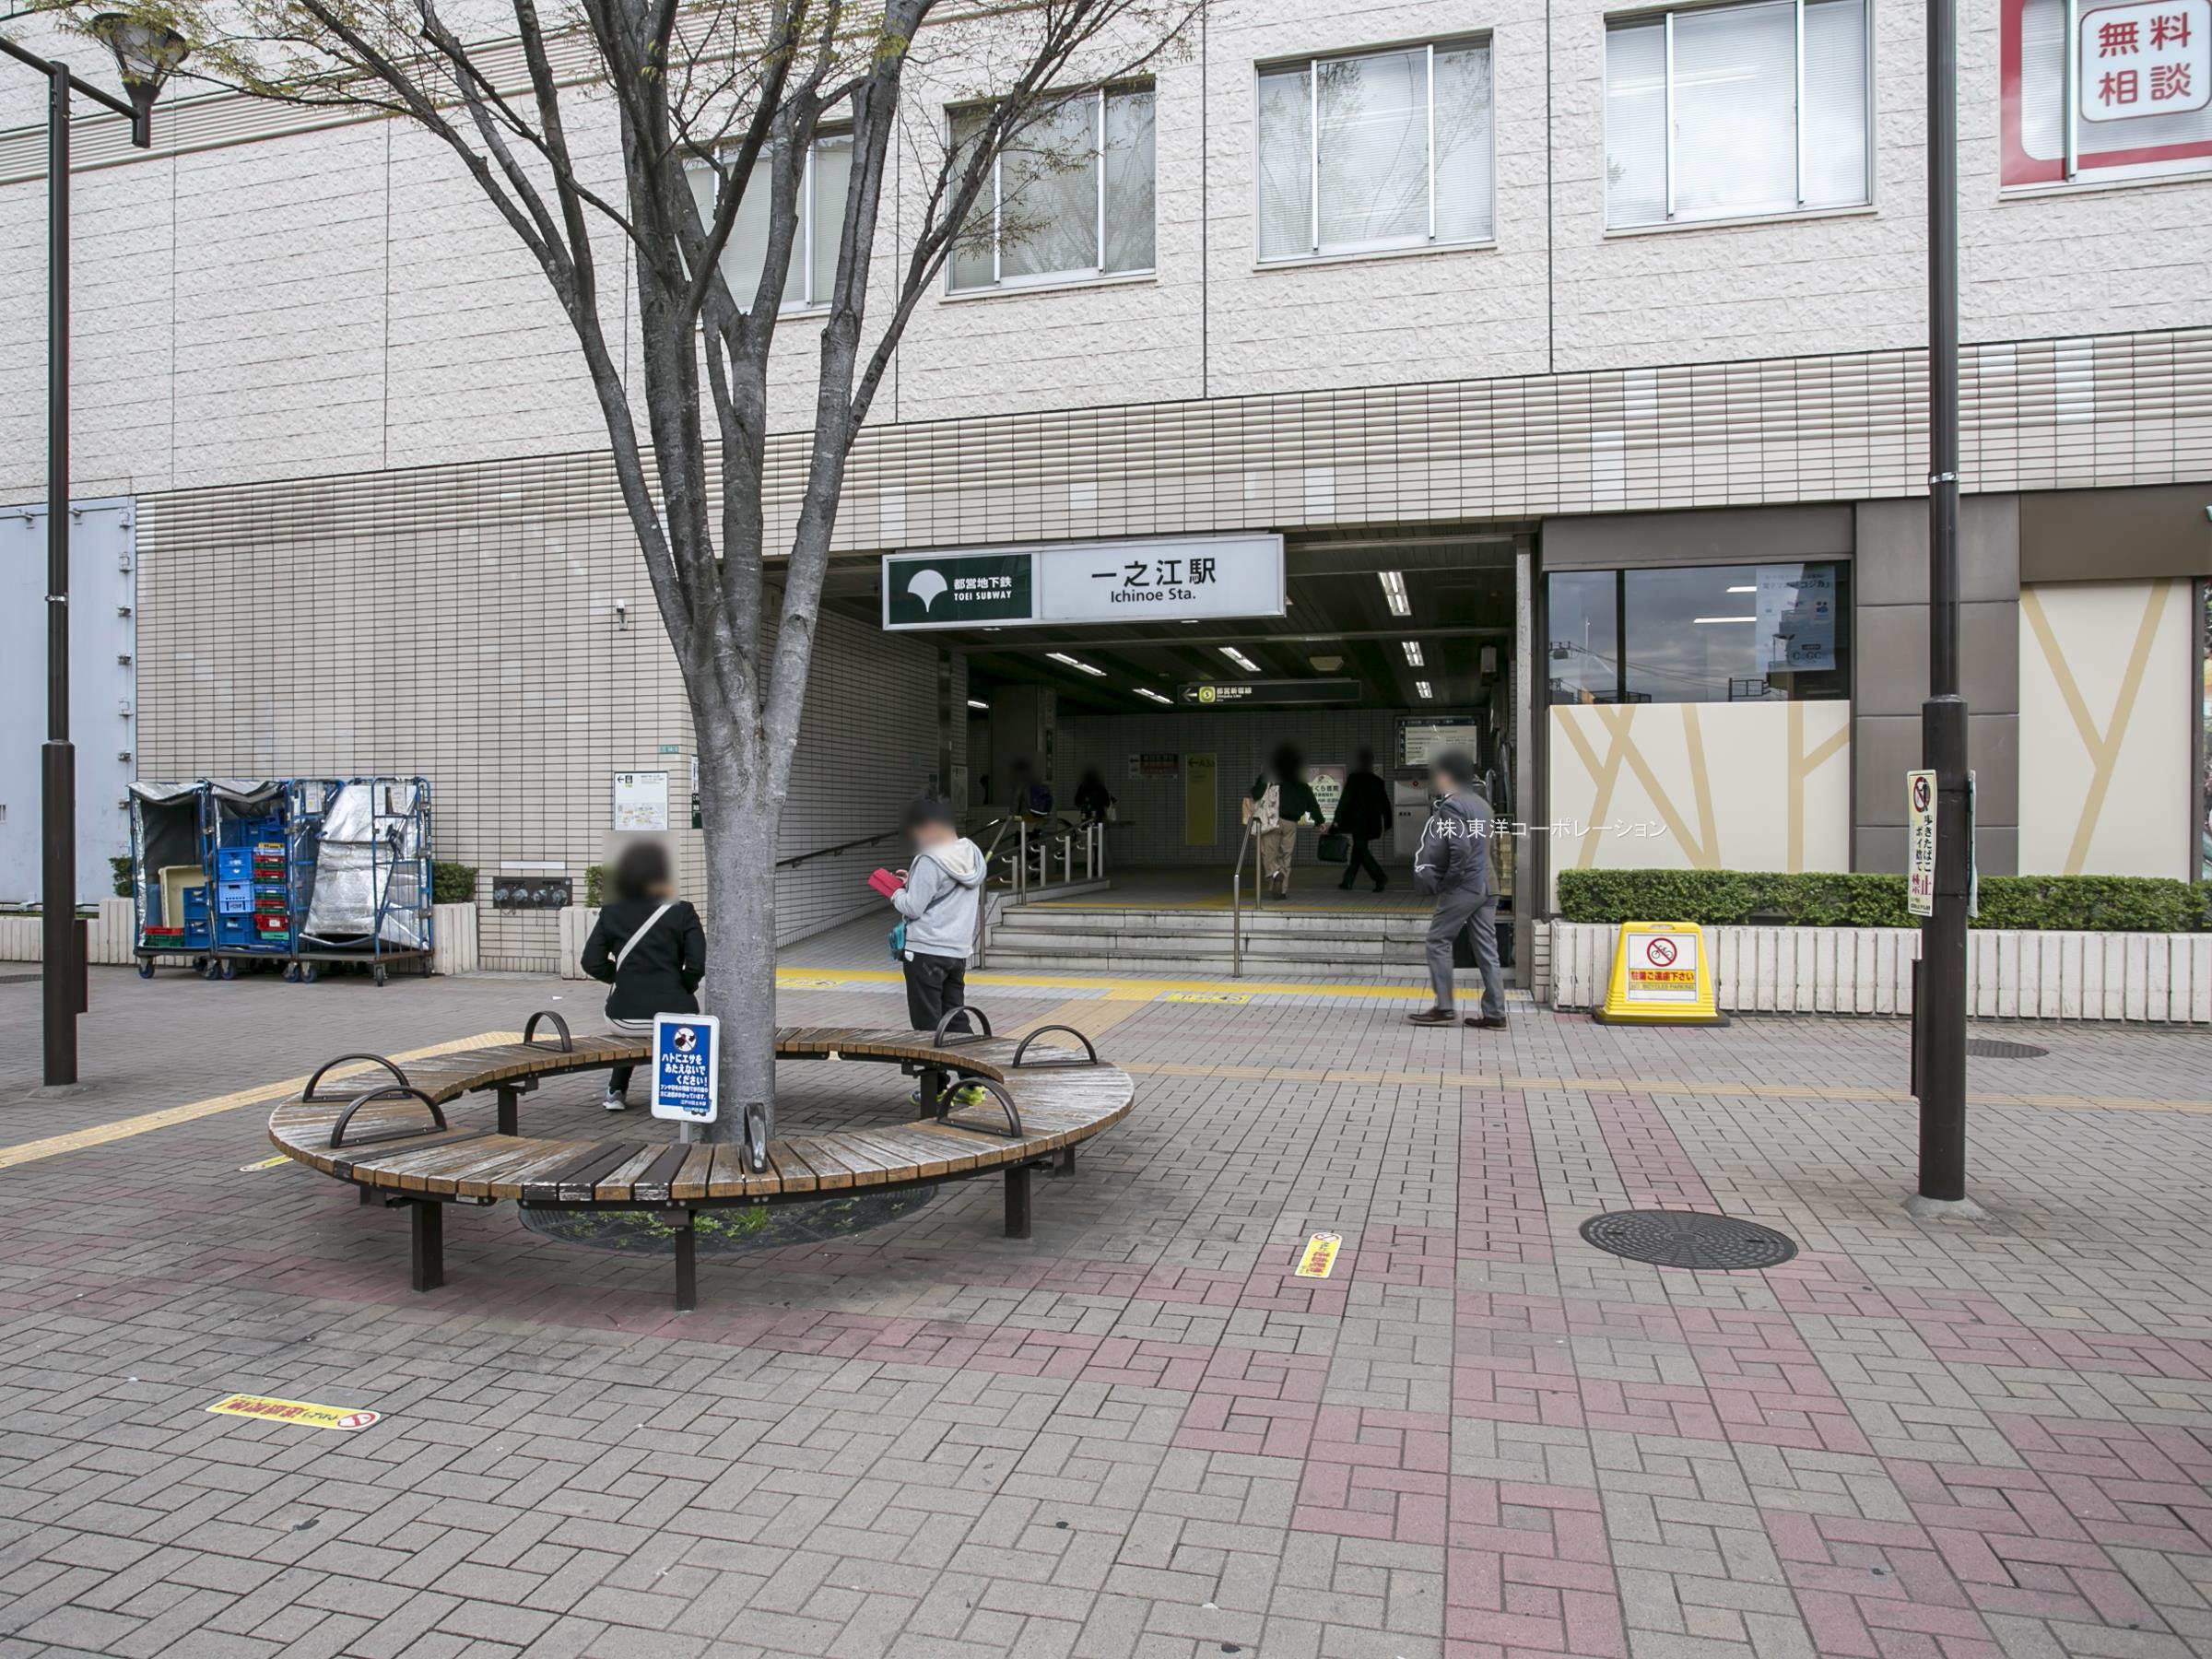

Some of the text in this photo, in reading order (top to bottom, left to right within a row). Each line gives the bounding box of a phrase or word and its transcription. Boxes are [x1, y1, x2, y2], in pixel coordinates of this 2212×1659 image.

[2098, 12, 2192, 58] 無料
[2098, 63, 2192, 107] 相談
[1091, 558, 1216, 587] 一之江駅
[954, 576, 1012, 590] 都営地下鉄
[954, 590, 1012, 601] TOEI SUBWAY
[1111, 588, 1196, 603] Ichinoe Sta.
[1912, 874, 1932, 896] 禁止
[662, 1053, 702, 1065] ハトにエサを
[665, 1064, 706, 1076] あたえないで
